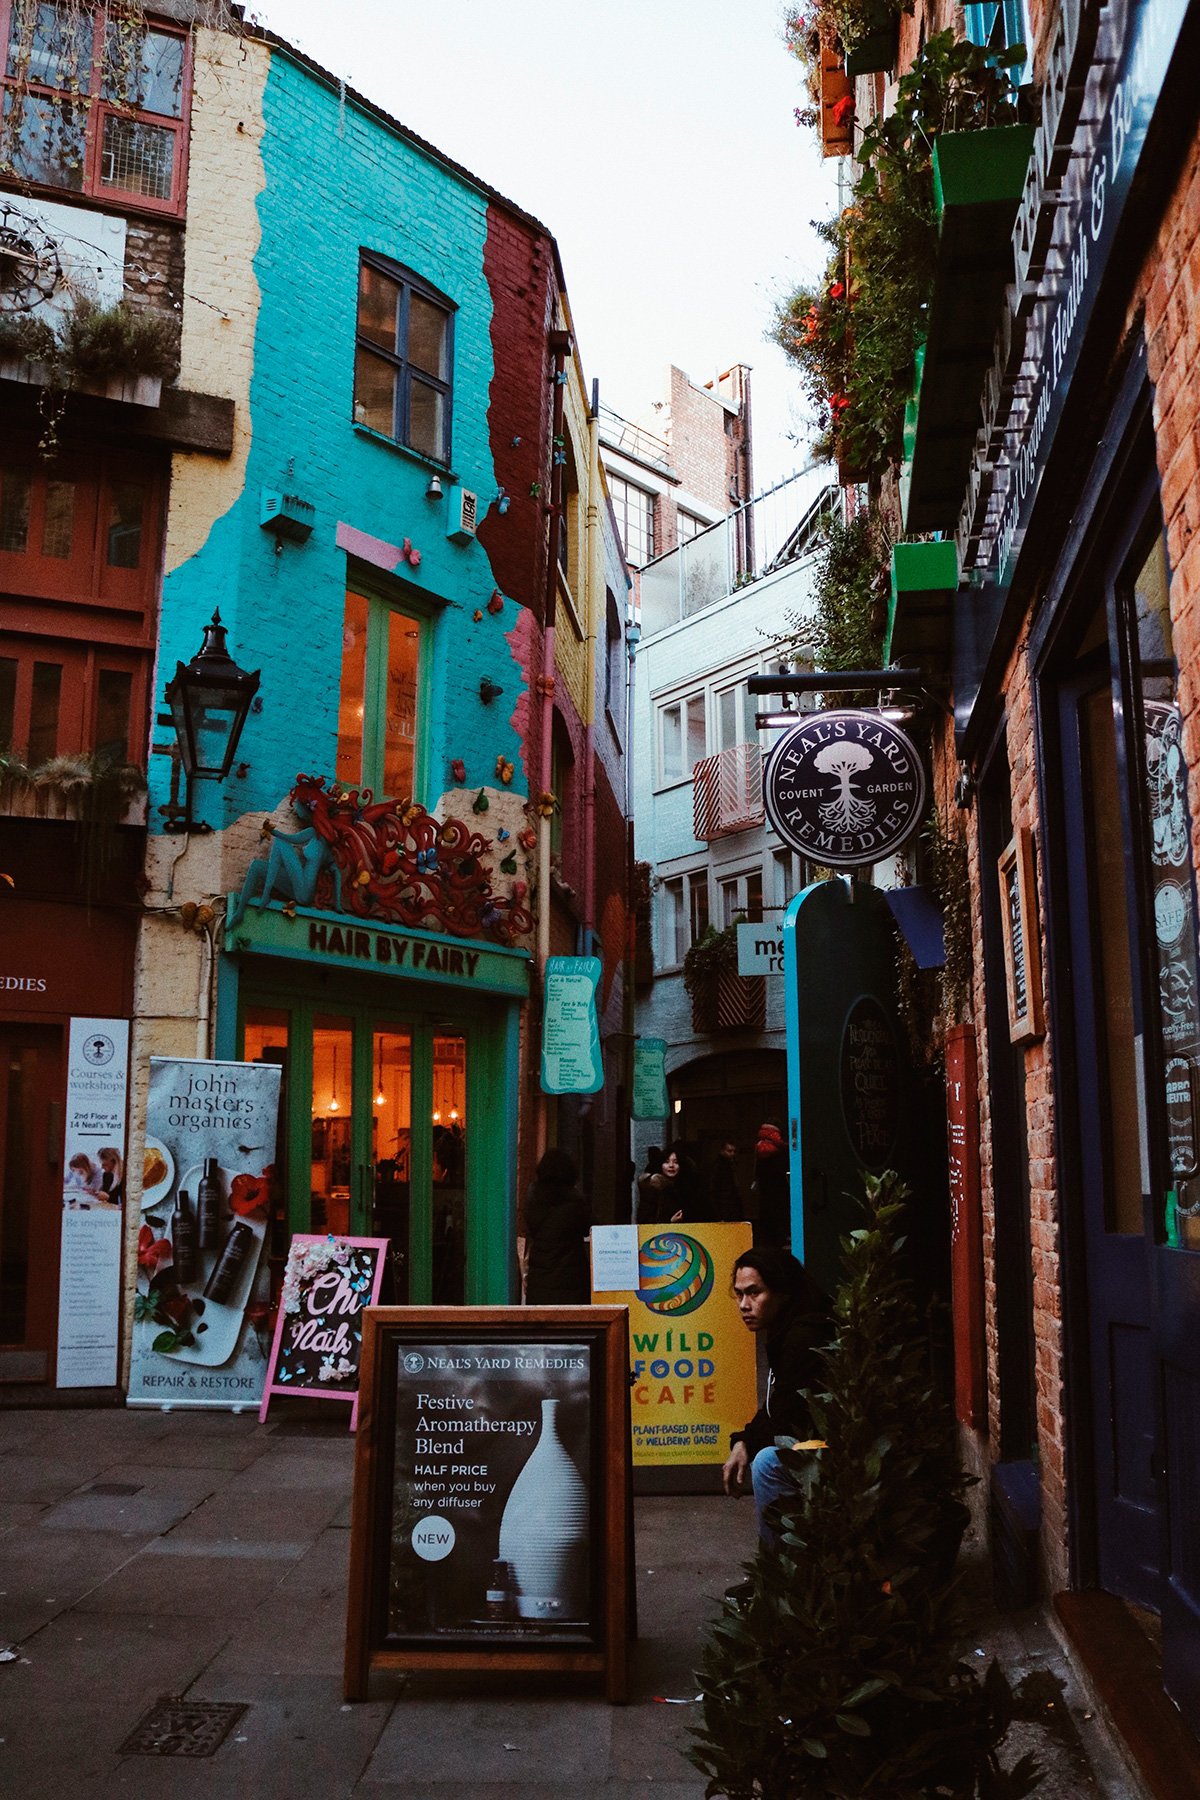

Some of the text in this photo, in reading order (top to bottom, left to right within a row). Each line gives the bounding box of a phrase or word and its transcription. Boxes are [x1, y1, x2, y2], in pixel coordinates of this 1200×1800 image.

[1051, 222, 1088, 396] Health
[1091, 155, 1107, 242] &
[779, 721, 910, 783] NEAL'S YARD
[779, 781, 913, 800] COVENT GARDEN
[784, 799, 910, 853] REMEDIES
[309, 923, 481, 977] HAIR BY FAIRY
[71, 1068, 125, 1080] Courses &
[69, 1080, 125, 1093] workshops
[187, 1073, 238, 1098] john
[169, 1094, 255, 1114] masters
[74, 1112, 89, 1120] 2nd
[90, 1112, 109, 1120] Floor
[168, 1111, 252, 1133] organics
[69, 1121, 80, 1129] 14
[82, 1121, 104, 1129] Neal's
[65, 1217, 119, 1230] Be inspired
[307, 1272, 363, 1316] Chi
[291, 1320, 352, 1355] Nails
[632, 1328, 715, 1353] WILD
[427, 1356, 585, 1370] NEAL'S YARD REMEDIES
[634, 1359, 715, 1379] FOOD
[142, 1375, 255, 1390] REPAIR & RESTORE
[416, 1393, 474, 1411] Festive
[415, 1416, 537, 1436] Aromatherapy
[633, 1424, 720, 1435] PLANT-BASED EATERY
[415, 1439, 465, 1455] Blend
[646, 1436, 691, 1446] WELLBEING
[693, 1435, 718, 1445] OASIS
[414, 1464, 488, 1477] HALF PRICE
[413, 1480, 496, 1495] when you buy
[412, 1498, 434, 1511] any
[416, 1533, 450, 1545] NEW
